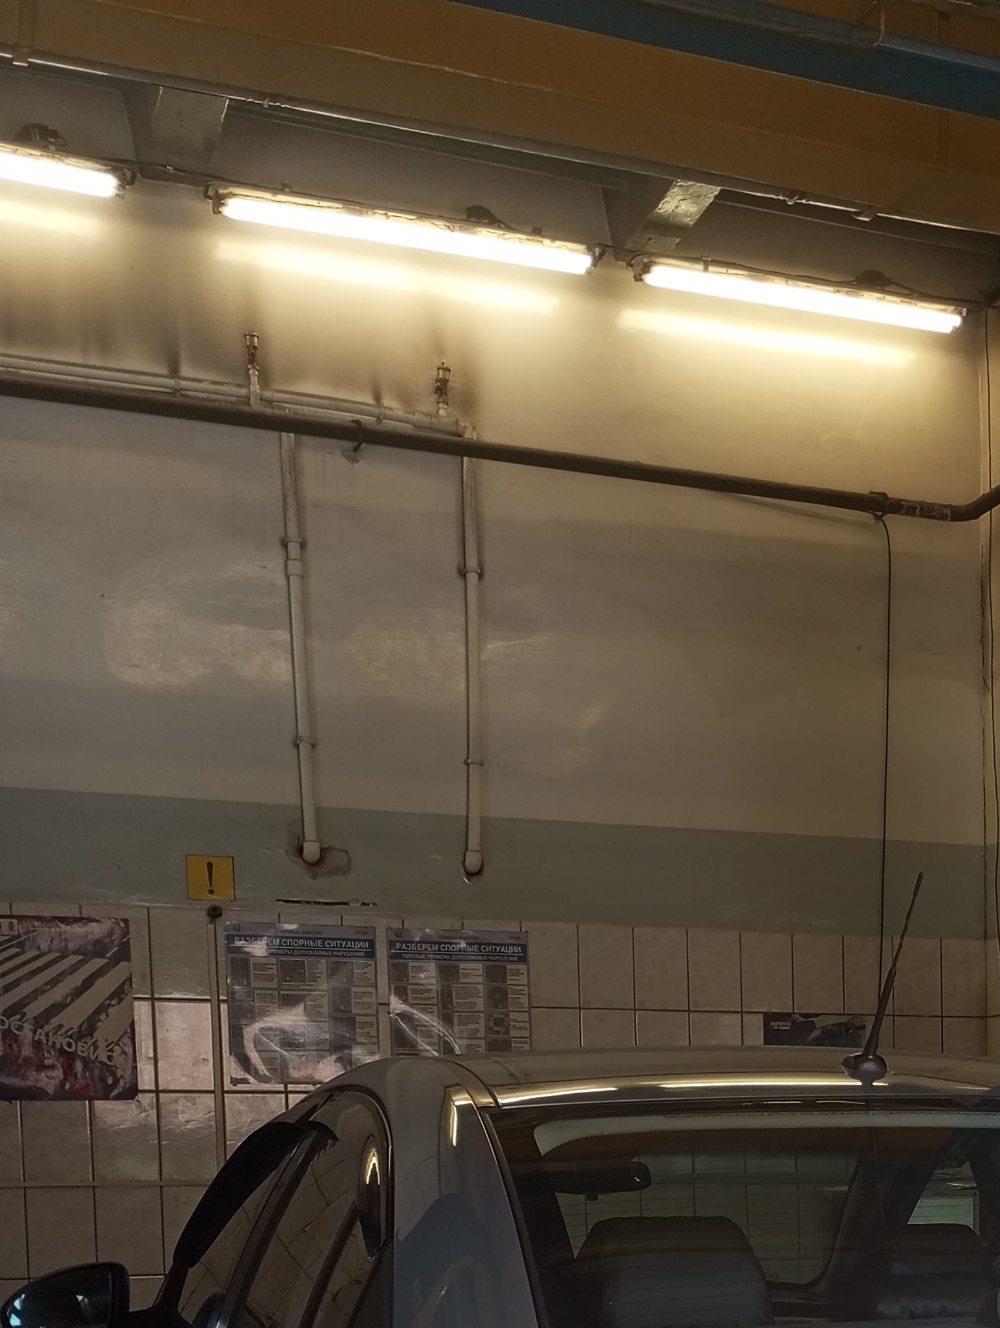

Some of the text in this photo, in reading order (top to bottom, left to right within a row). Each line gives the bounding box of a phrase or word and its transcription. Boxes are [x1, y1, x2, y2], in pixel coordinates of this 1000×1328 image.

[281, 937, 323, 948] СПОРНЫЕ
[325, 939, 370, 950] СИТУАЦИИ
[396, 942, 522, 954] РАЗБЕРЕМ СПОРНЫЕ СИТУАЦИИ
